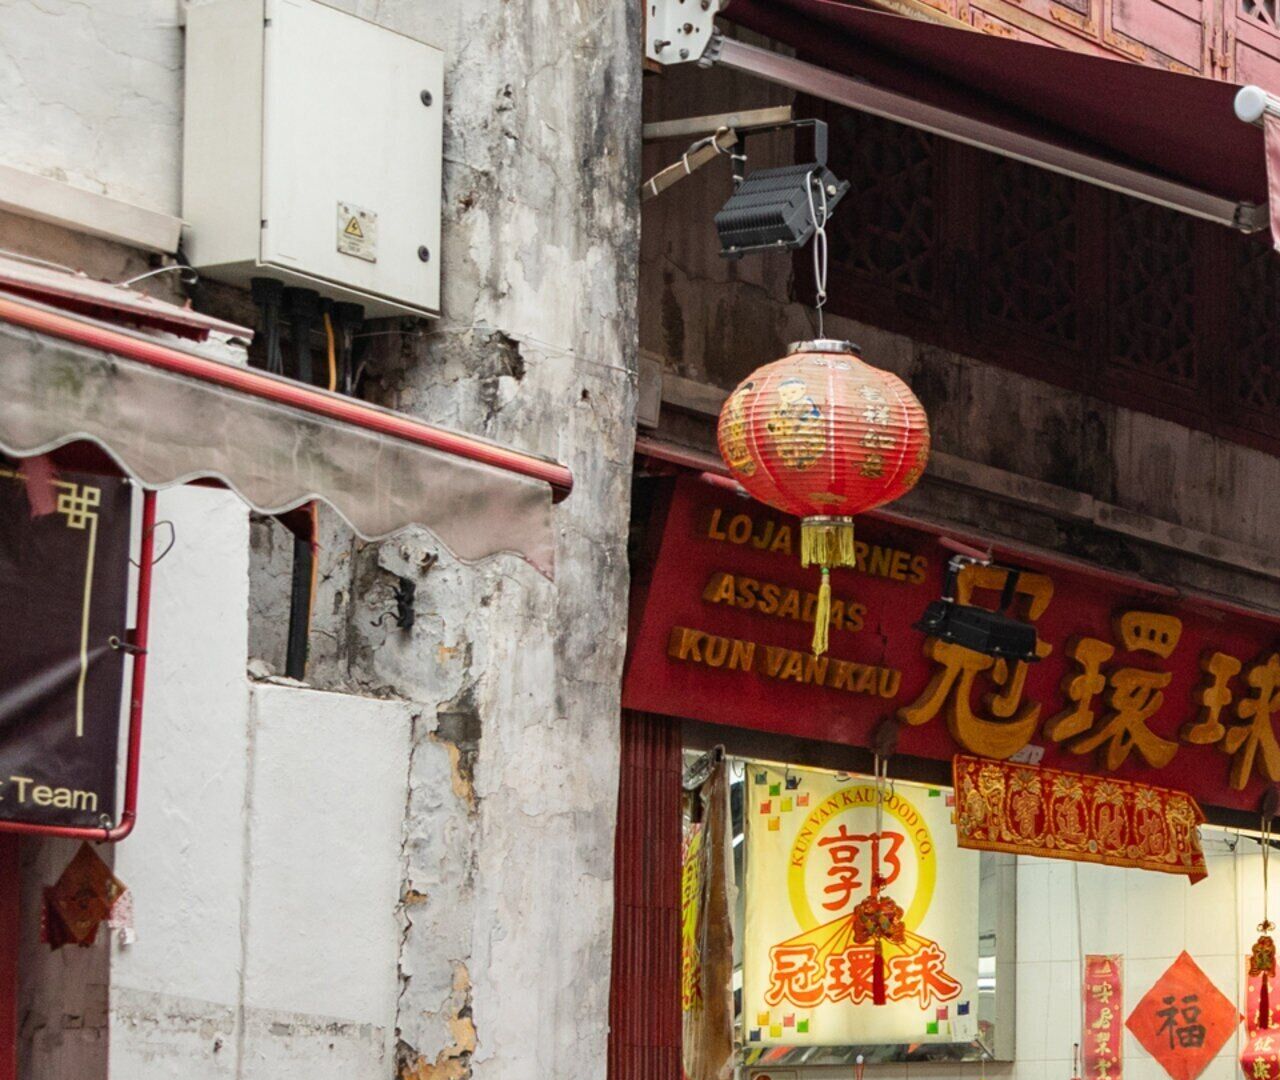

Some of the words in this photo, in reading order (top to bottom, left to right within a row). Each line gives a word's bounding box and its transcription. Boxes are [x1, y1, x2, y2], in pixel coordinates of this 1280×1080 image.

[707, 509, 793, 556] LOJA
[672, 626, 756, 673] KUN
[764, 646, 830, 687] VAN
[833, 660, 902, 699] KAU
[10, 776, 98, 812] Team
[792, 827, 812, 868] KUN
[811, 799, 841, 828] VAN
[841, 790, 876, 806] KAU
[914, 828, 933, 861] CO.
[818, 825, 905, 911] 郭
[764, 943, 962, 1010] 冠環球
[1155, 994, 1207, 1050] 福
